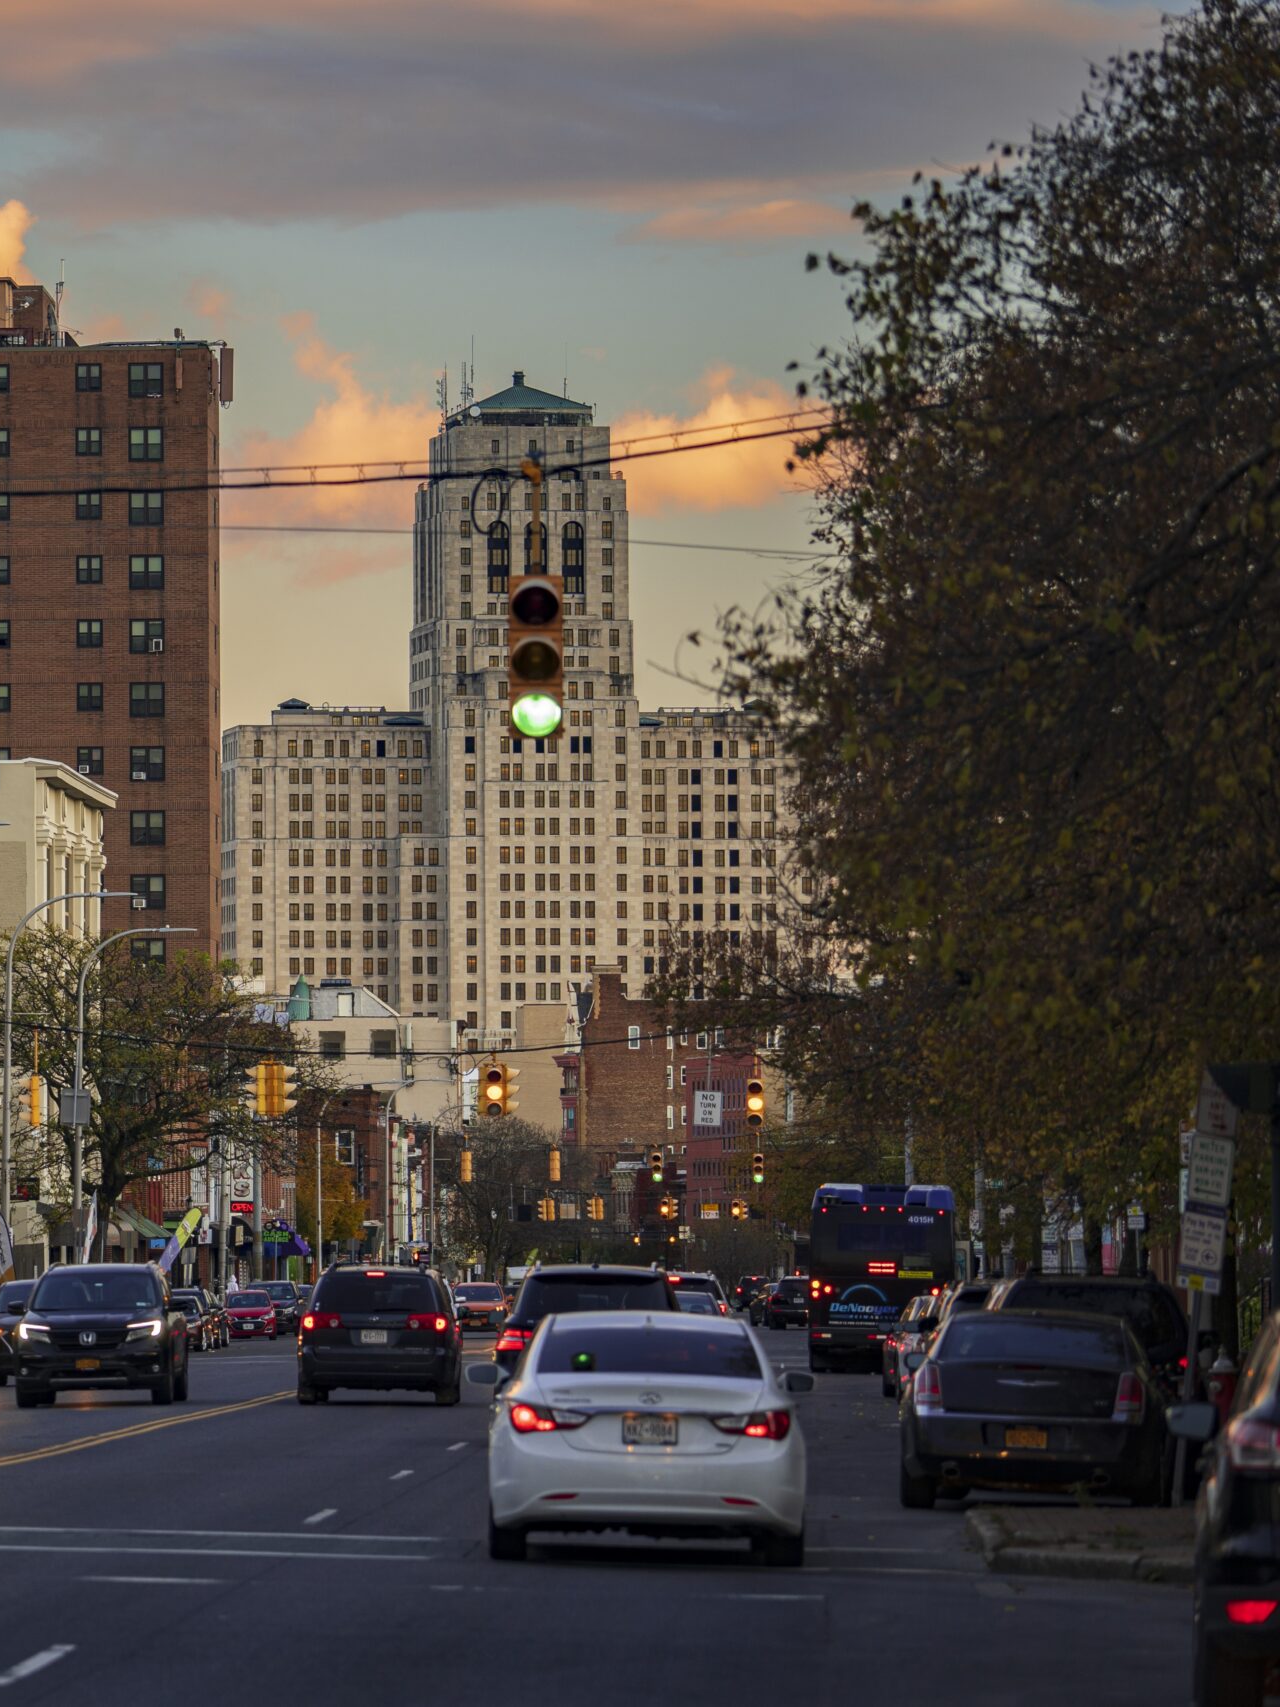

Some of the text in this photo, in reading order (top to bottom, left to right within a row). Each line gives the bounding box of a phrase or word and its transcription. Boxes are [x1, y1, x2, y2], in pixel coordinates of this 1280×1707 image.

[231, 1203, 253, 1212] OPEN
[908, 1215, 934, 1224] 4015H
[829, 1303, 899, 1314] DeNooyer
